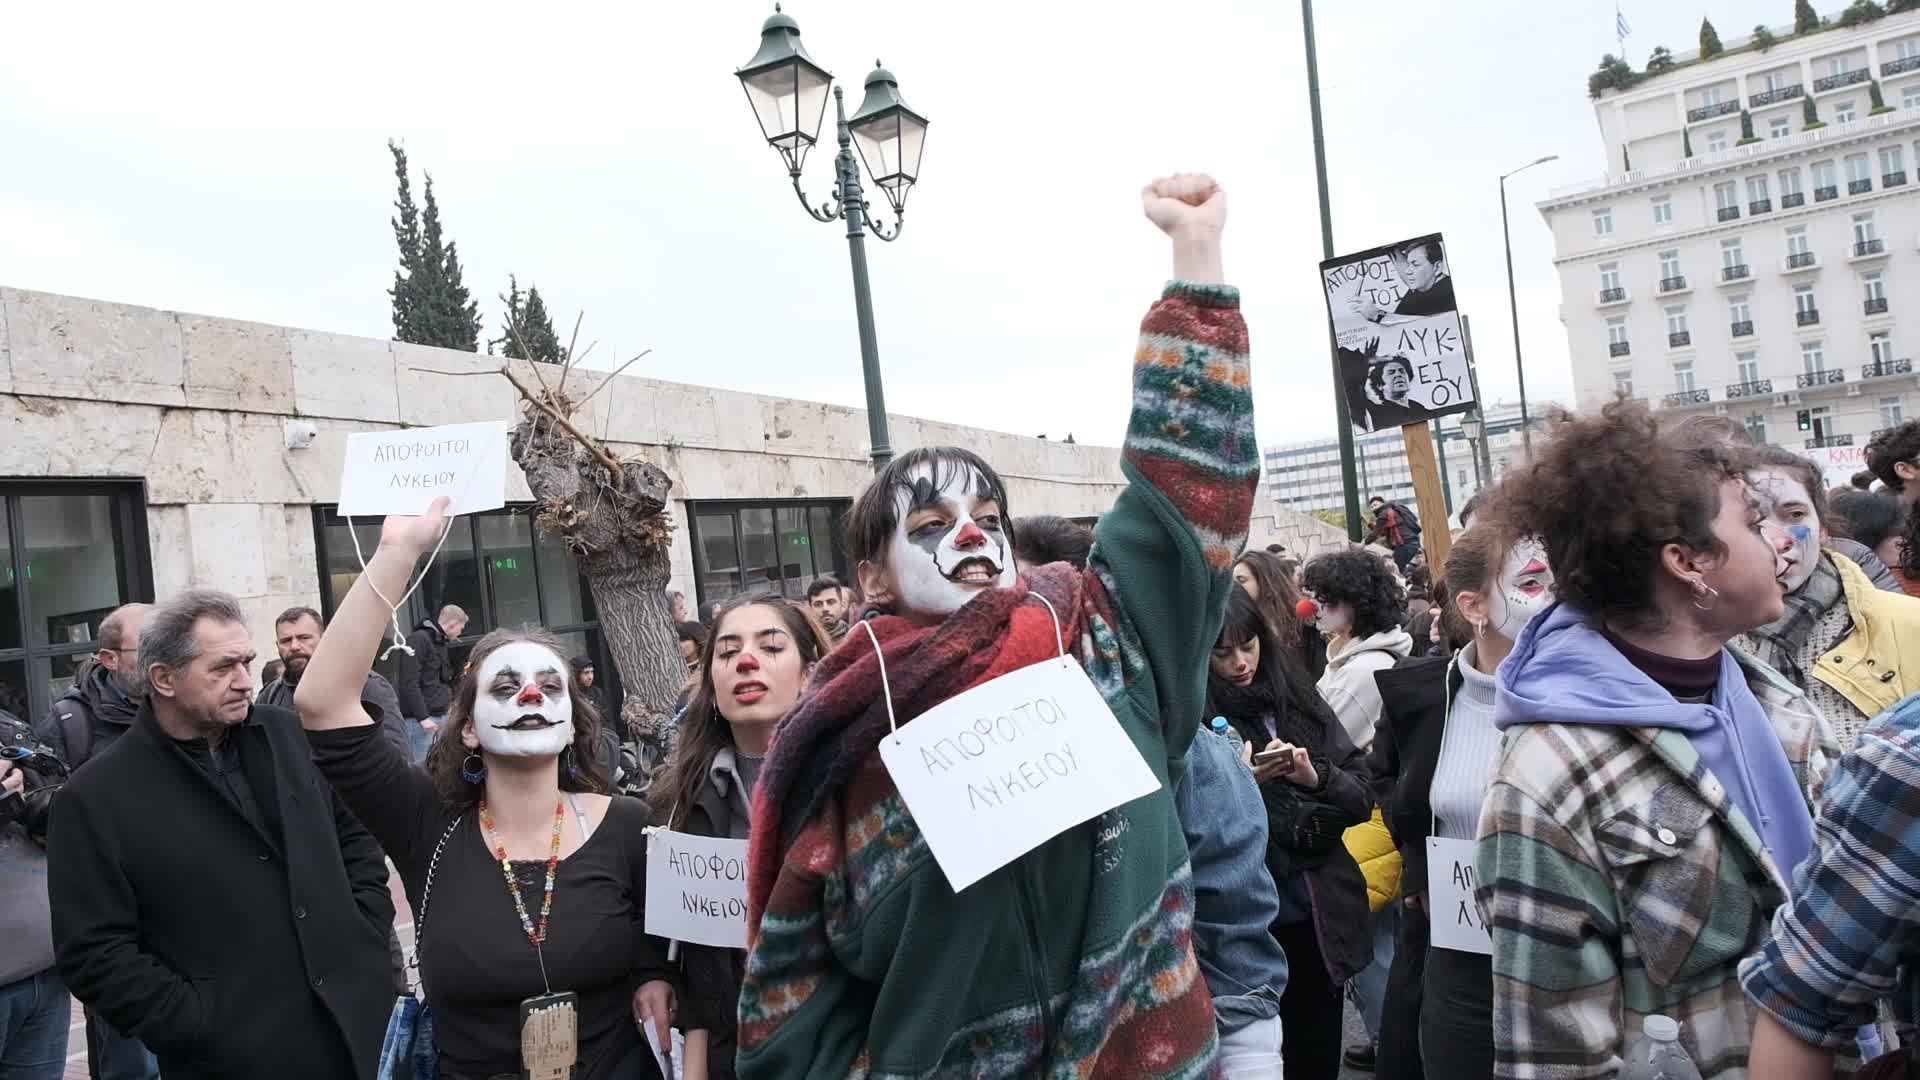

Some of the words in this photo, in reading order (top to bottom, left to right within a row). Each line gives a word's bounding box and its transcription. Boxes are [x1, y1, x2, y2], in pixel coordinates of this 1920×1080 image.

[1364, 285, 1403, 306] ΤΟΙ
[1398, 327, 1457, 357] ΛΥΚ-
[1418, 360, 1449, 385] ΕΙ
[1431, 375, 1462, 407] ΟΥ
[374, 439, 471, 464] ΑΠΟΦΟΙΤΟΙ
[390, 471, 456, 489] ΛΥΚΕΙΟΥ
[919, 695, 1069, 777] ΑΠΟΦΟΙΤΟΙ
[966, 741, 1079, 811] ΛΥΚΕΙΟΥ
[682, 889, 748, 923] ΛΥΚΕΙΟΥ
